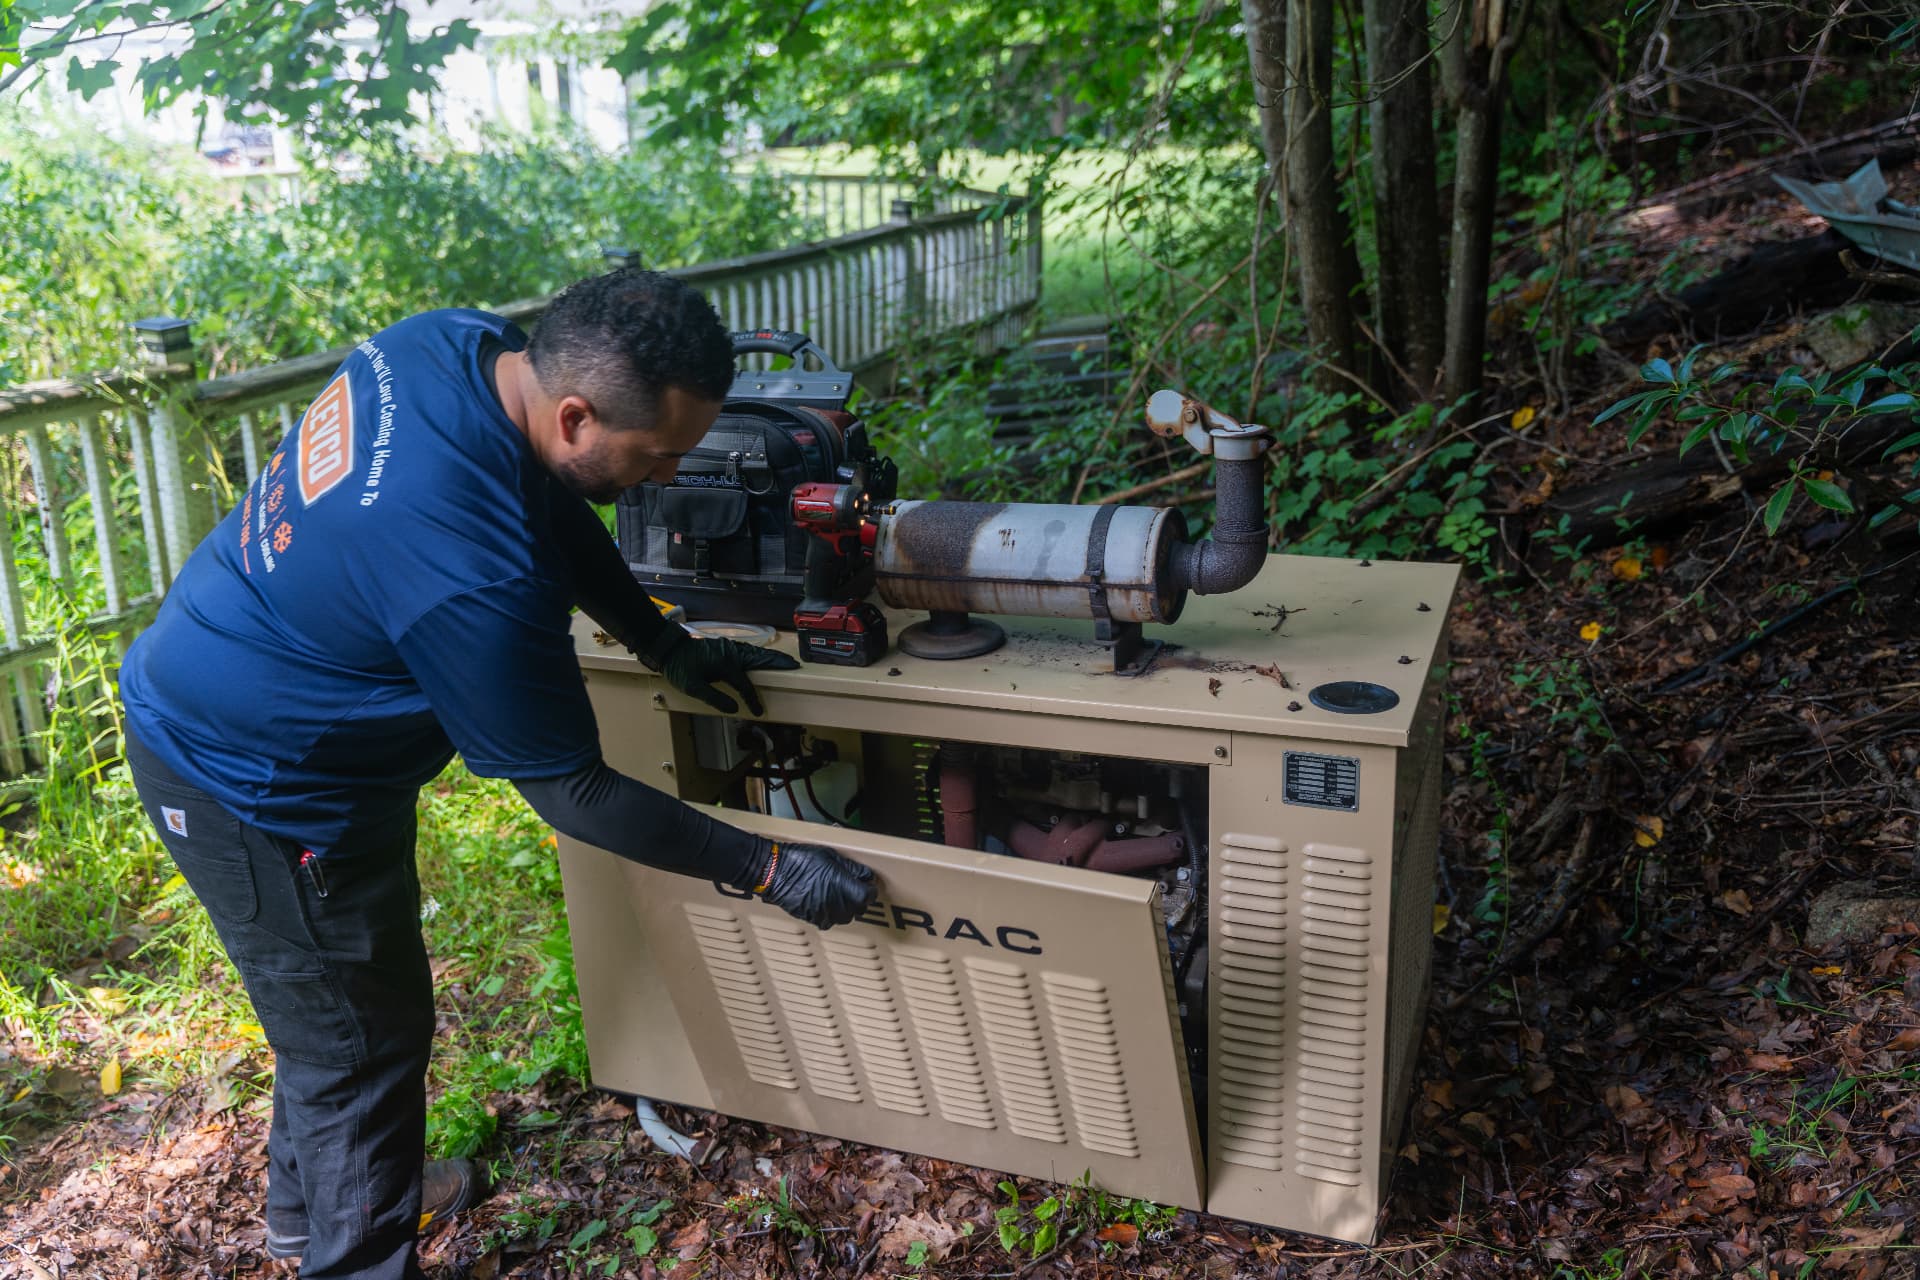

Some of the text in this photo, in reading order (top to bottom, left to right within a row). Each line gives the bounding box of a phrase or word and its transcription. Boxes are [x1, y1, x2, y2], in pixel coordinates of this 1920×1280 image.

[371, 352, 392, 381] You'll
[378, 377, 394, 404] Love
[308, 387, 342, 484] LEVCO
[373, 404, 397, 447] Coming
[366, 450, 392, 487] Home
[360, 491, 379, 506] To
[712, 880, 1043, 955] GERAC
